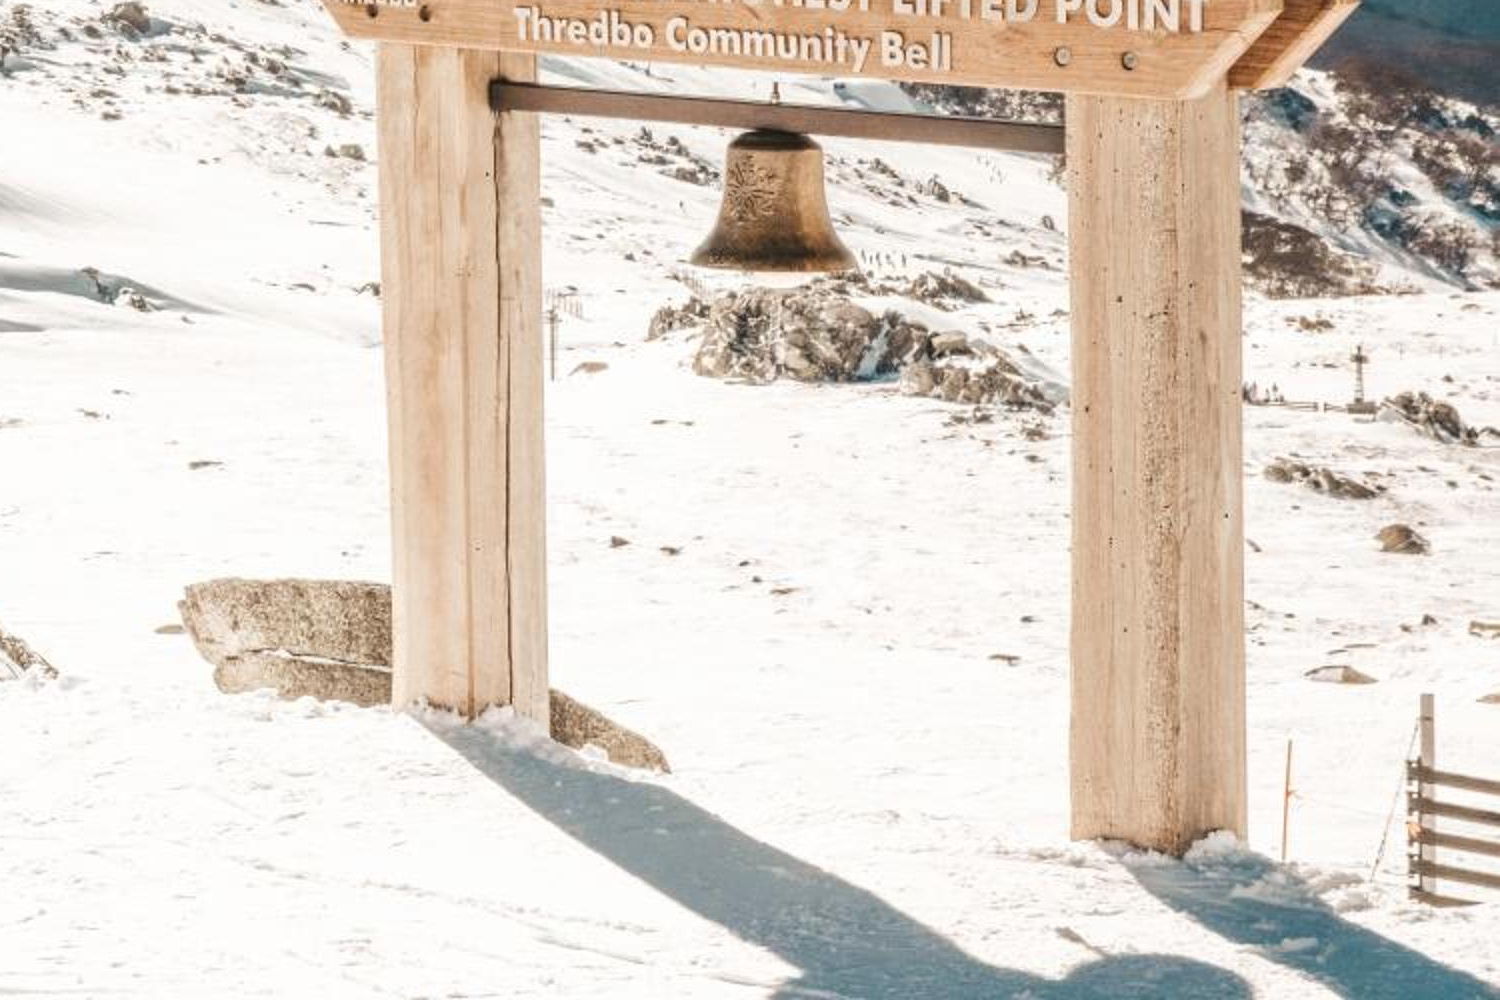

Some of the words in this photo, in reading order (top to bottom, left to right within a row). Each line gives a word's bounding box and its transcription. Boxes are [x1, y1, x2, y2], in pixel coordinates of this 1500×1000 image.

[514, 6, 653, 47] Thredbo
[665, 17, 871, 73] Community
[881, 31, 952, 72] Bell
